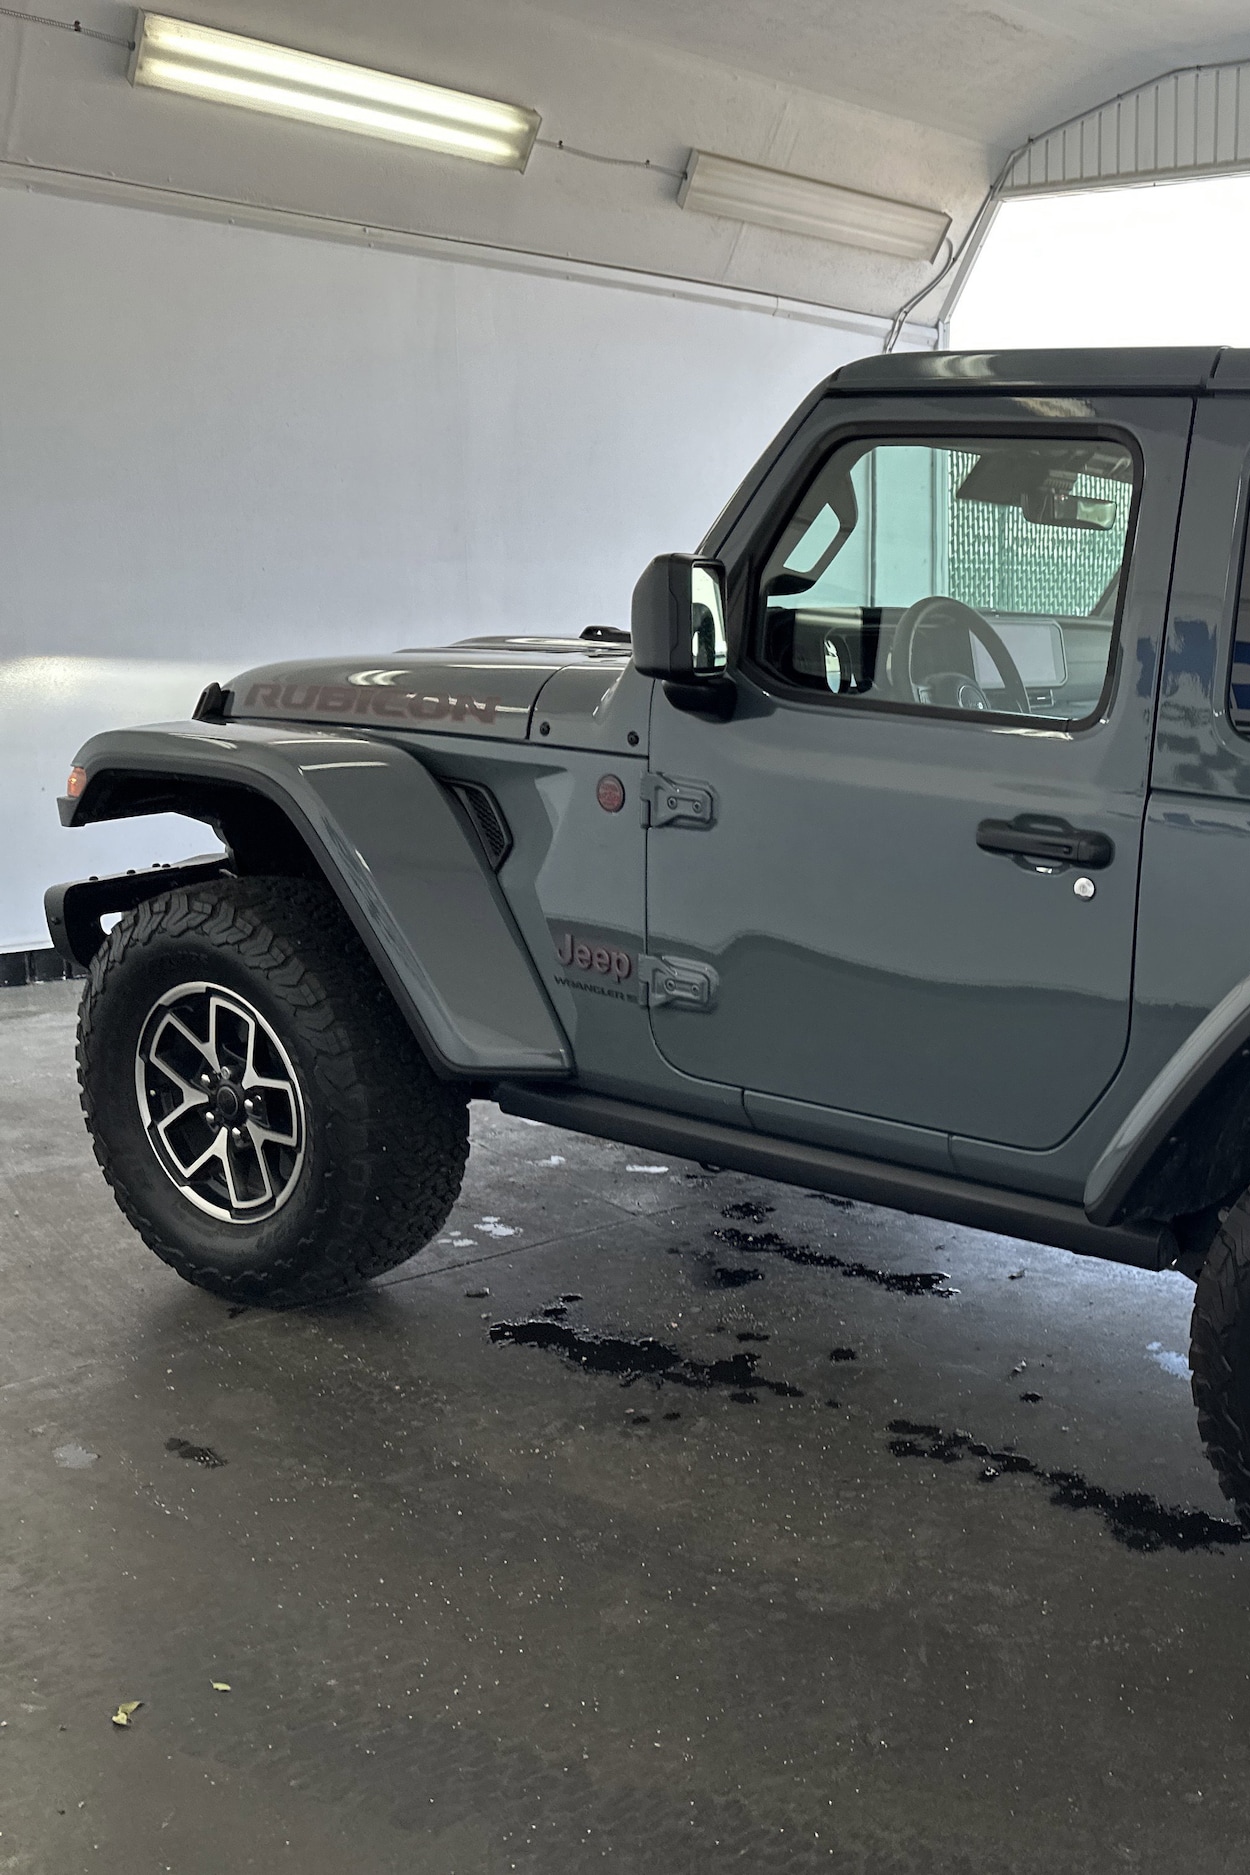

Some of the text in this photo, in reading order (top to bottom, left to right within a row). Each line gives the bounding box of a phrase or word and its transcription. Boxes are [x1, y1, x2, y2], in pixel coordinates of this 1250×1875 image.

[243, 683, 502, 725] RUBICON
[557, 933, 632, 984] Jeep
[553, 975, 625, 1001] WRANGLER
